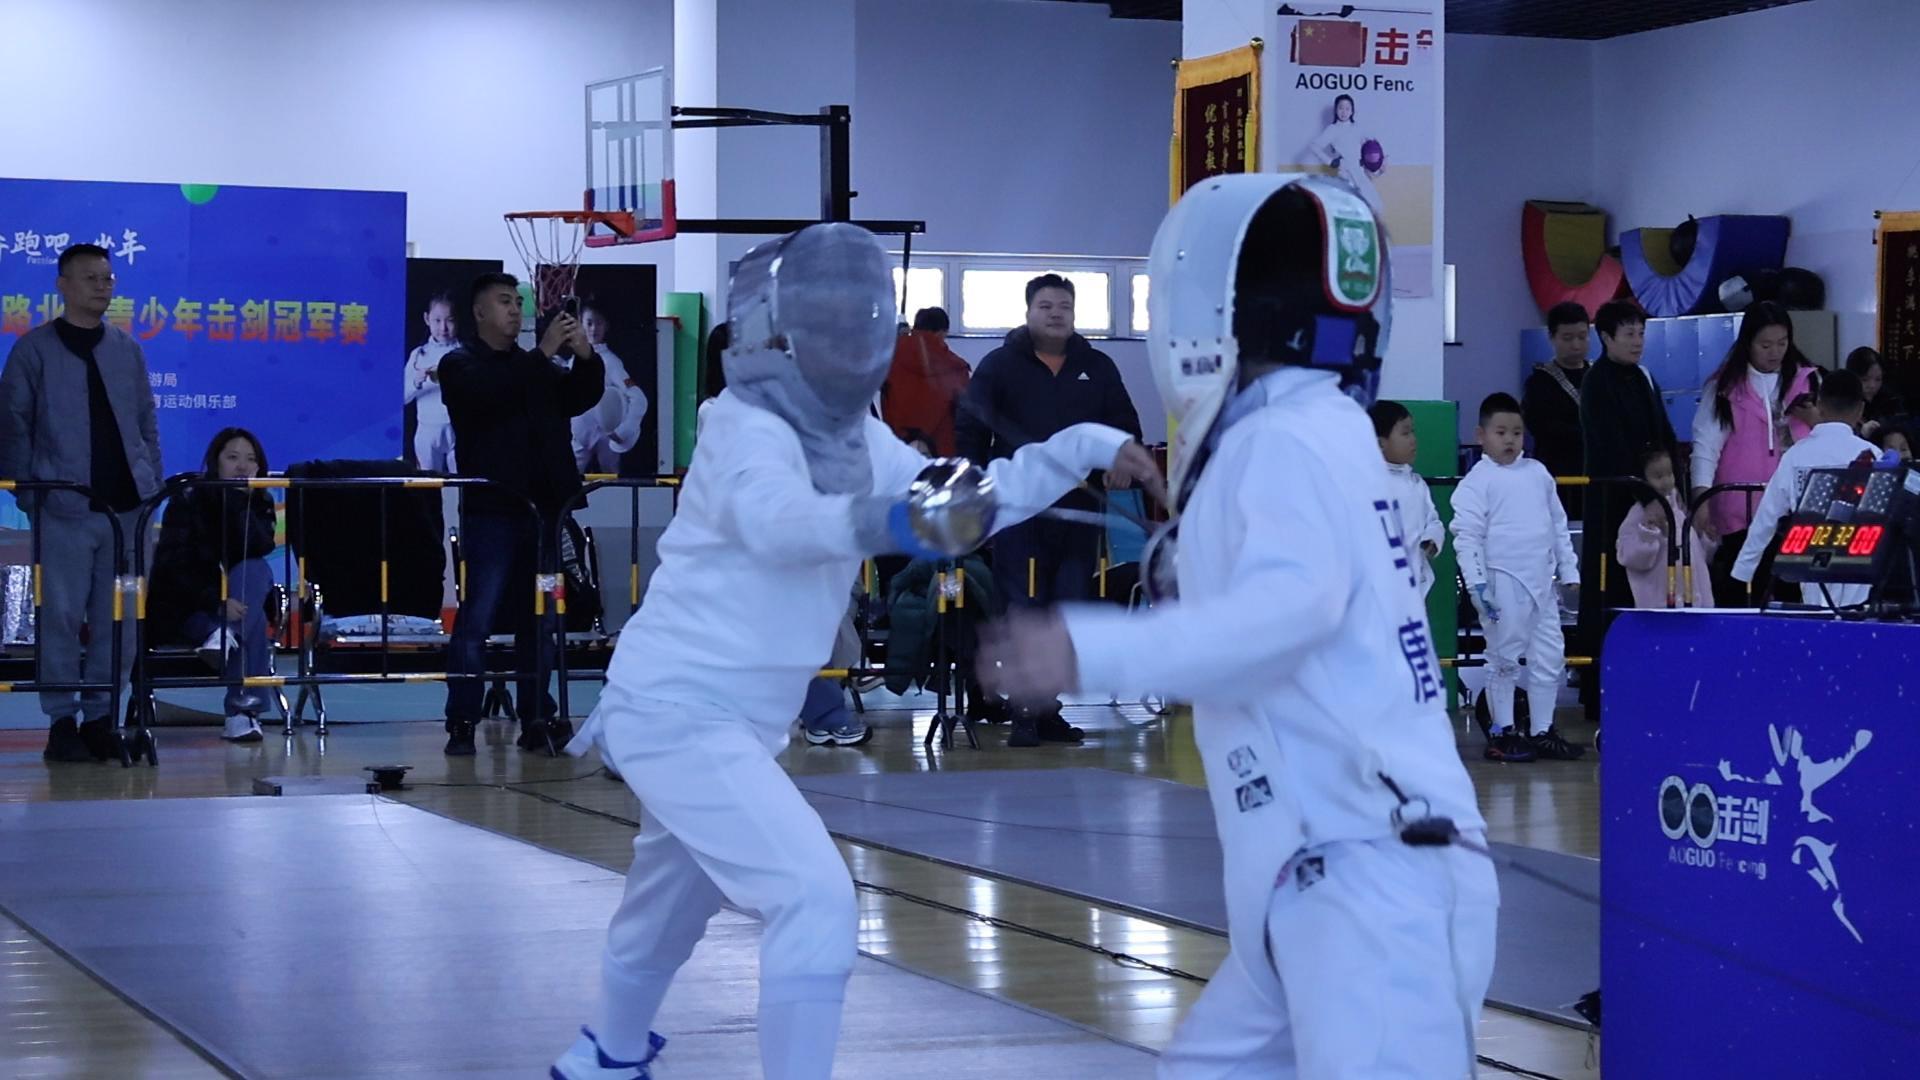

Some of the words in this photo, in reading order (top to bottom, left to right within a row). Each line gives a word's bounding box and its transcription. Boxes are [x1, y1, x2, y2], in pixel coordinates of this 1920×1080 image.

[1295, 73, 1368, 91] AOGUO
[1373, 75, 1415, 92] Fenc
[2, 294, 369, 345] 路北青少年击剑冠军赛
[1668, 846, 1716, 868] AOGUO
